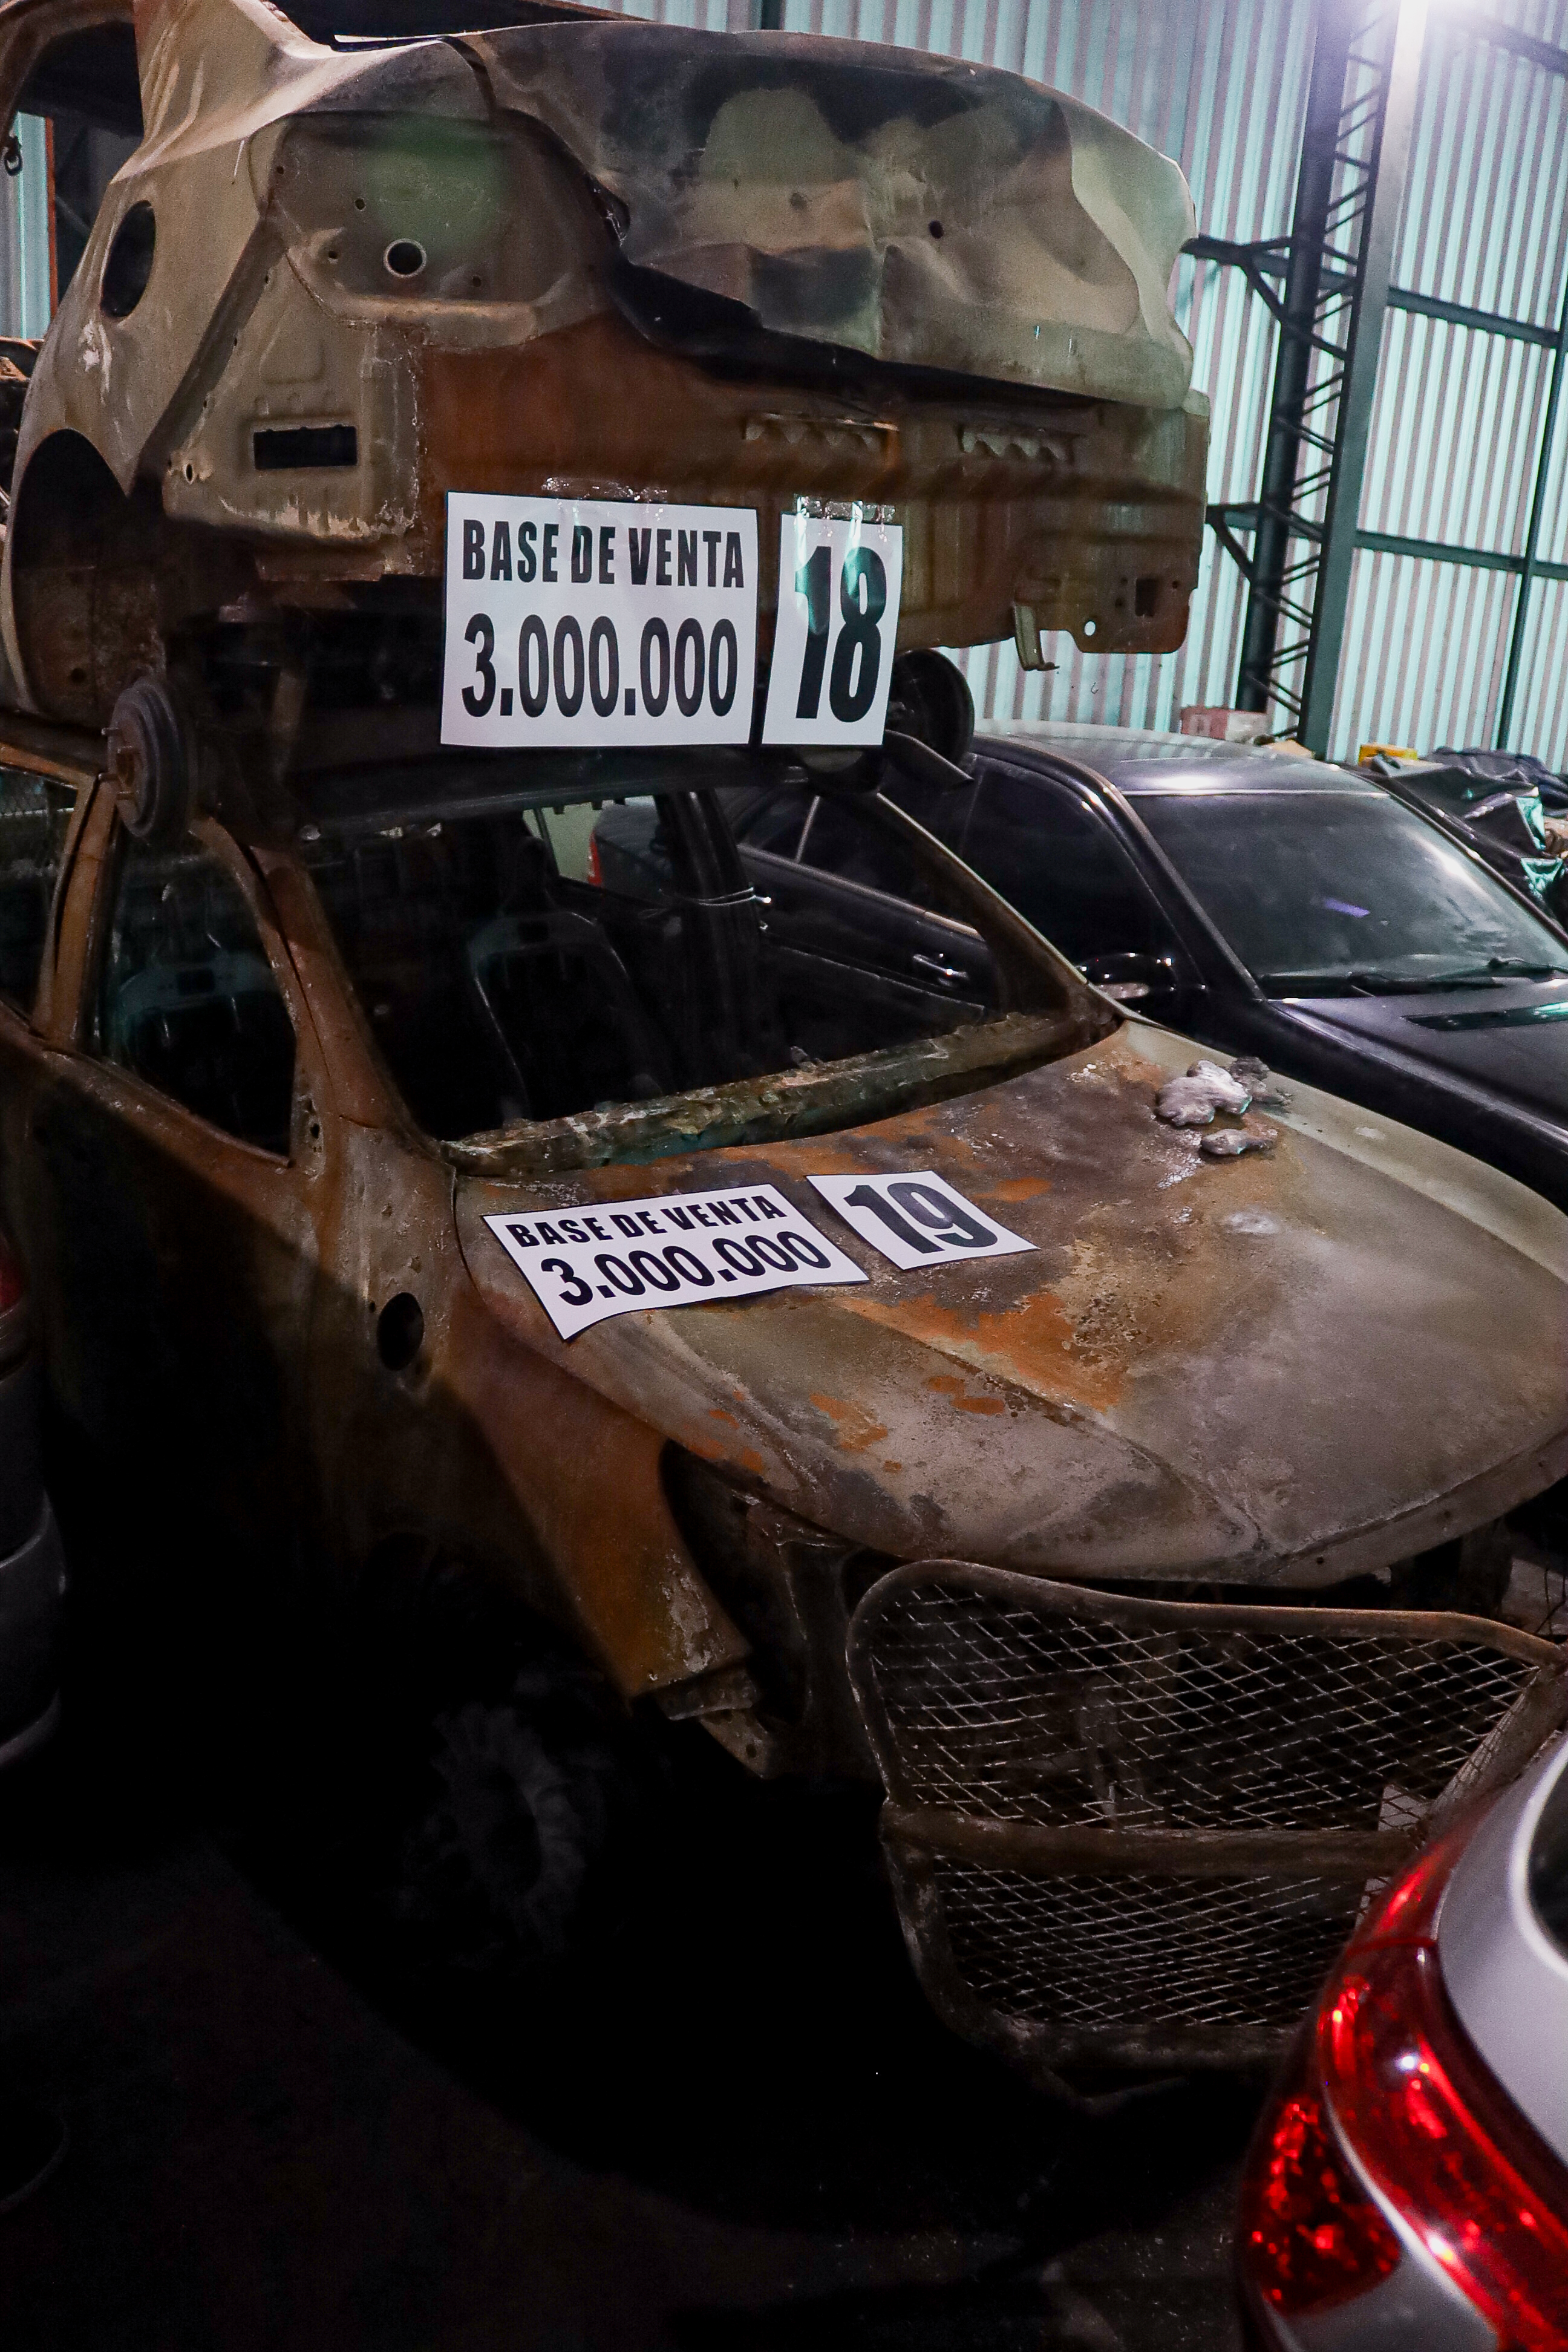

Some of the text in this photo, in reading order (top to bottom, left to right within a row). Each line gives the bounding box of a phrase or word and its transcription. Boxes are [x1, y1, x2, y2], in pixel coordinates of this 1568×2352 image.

[463, 520, 744, 588] BASE DE VENTA
[461, 613, 738, 718] 3.000.000
[794, 545, 887, 723] 18
[506, 1195, 787, 1248] BASE DE VENTA
[843, 1183, 999, 1254] 19
[540, 1231, 831, 1306] 3.000.000
